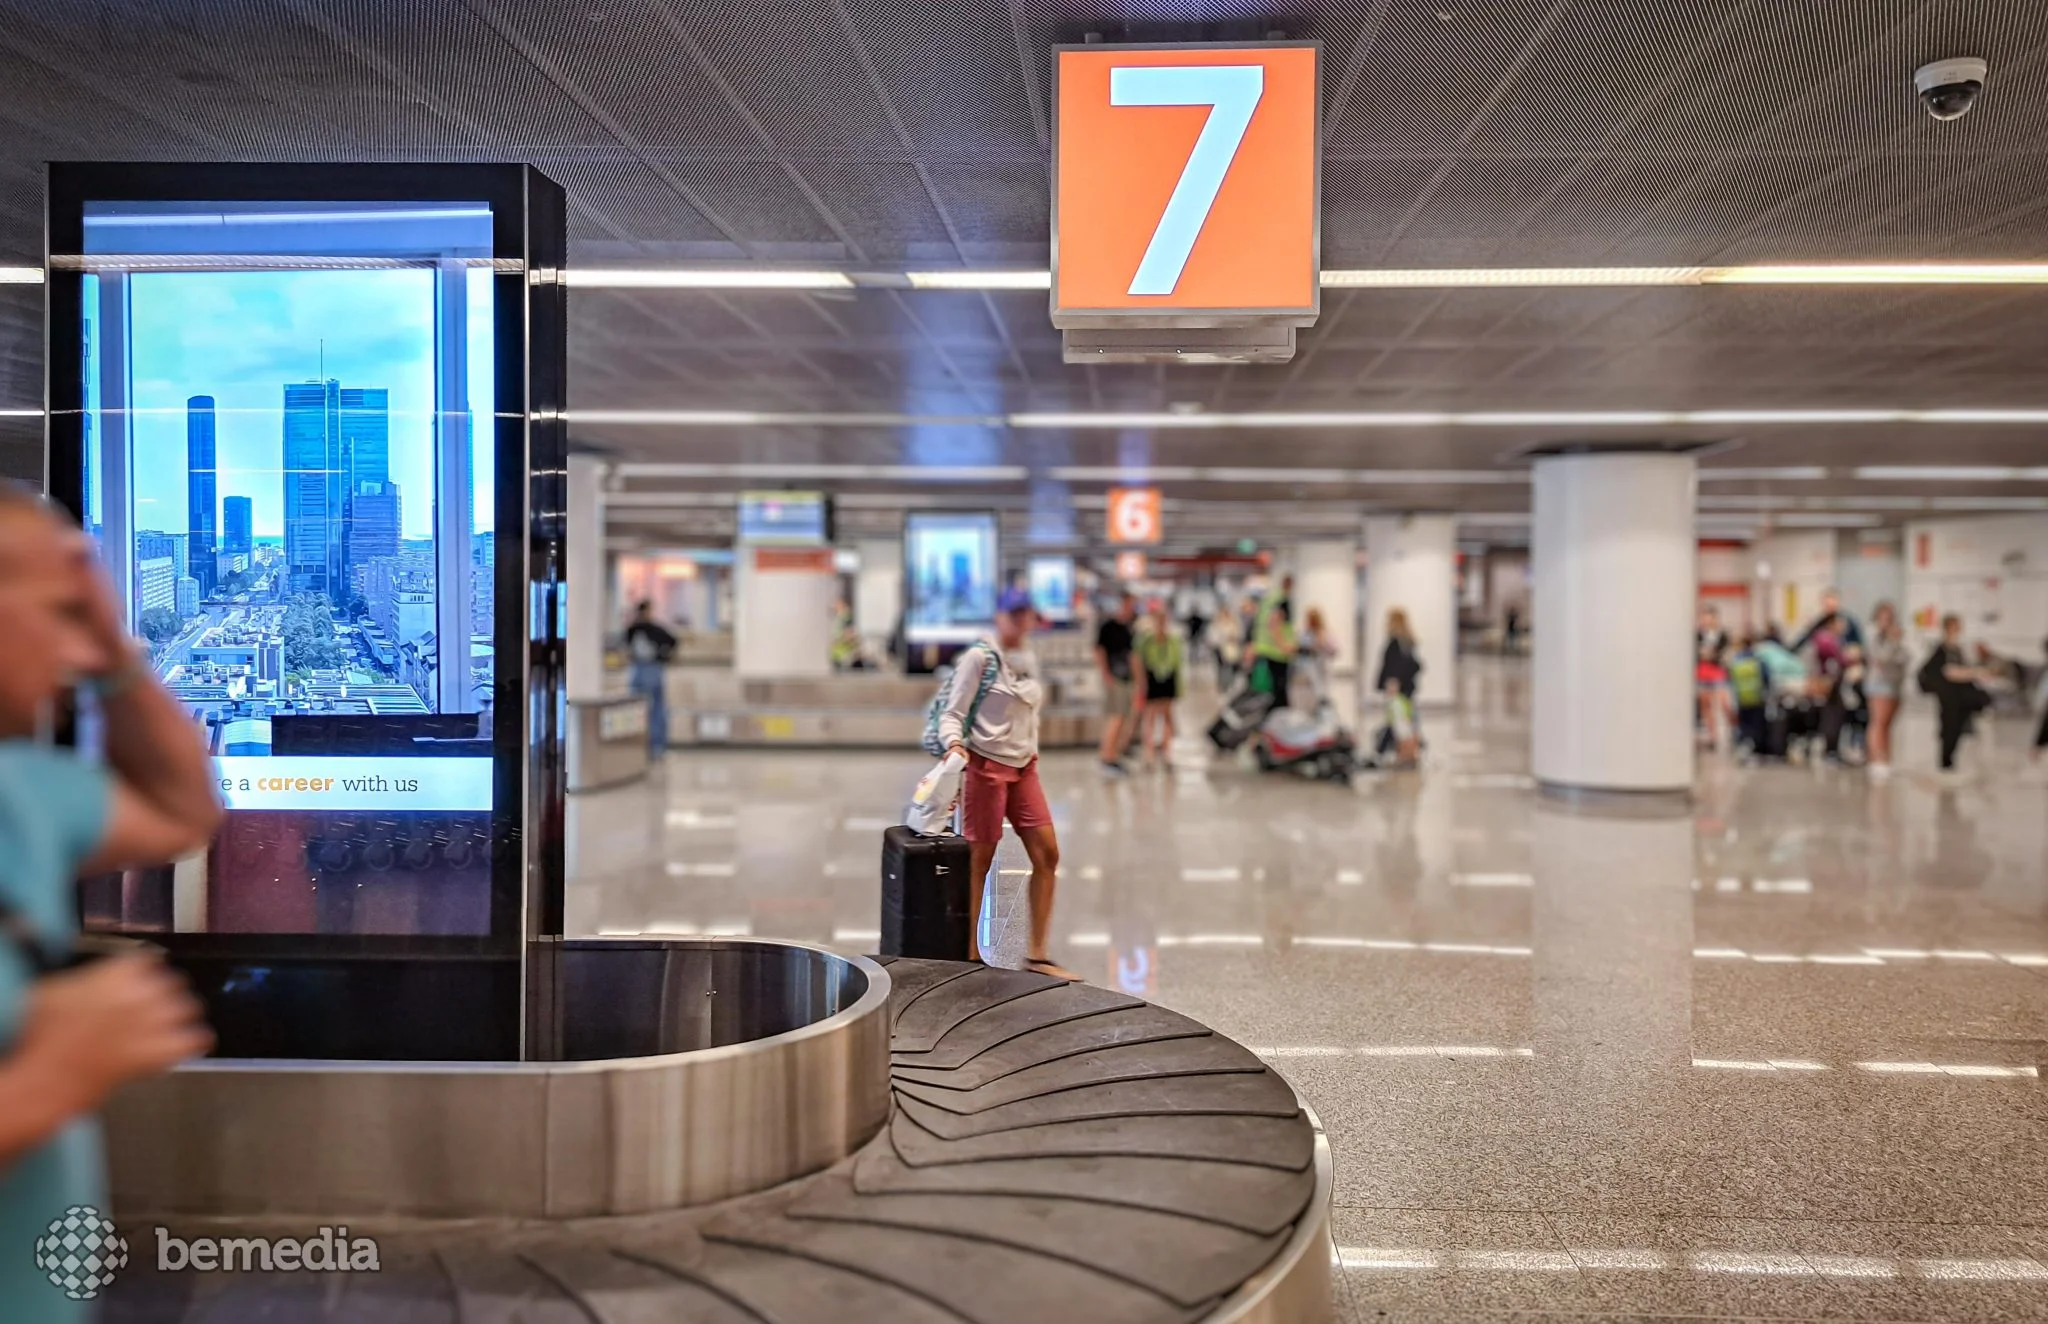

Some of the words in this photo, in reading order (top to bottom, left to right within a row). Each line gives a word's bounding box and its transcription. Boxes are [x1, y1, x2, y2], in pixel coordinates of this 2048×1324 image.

[1110, 65, 1263, 295] 7
[1117, 490, 1150, 540] 6
[239, 778, 250, 791] a
[257, 777, 334, 791] career
[342, 775, 389, 792] with
[394, 779, 418, 792] us
